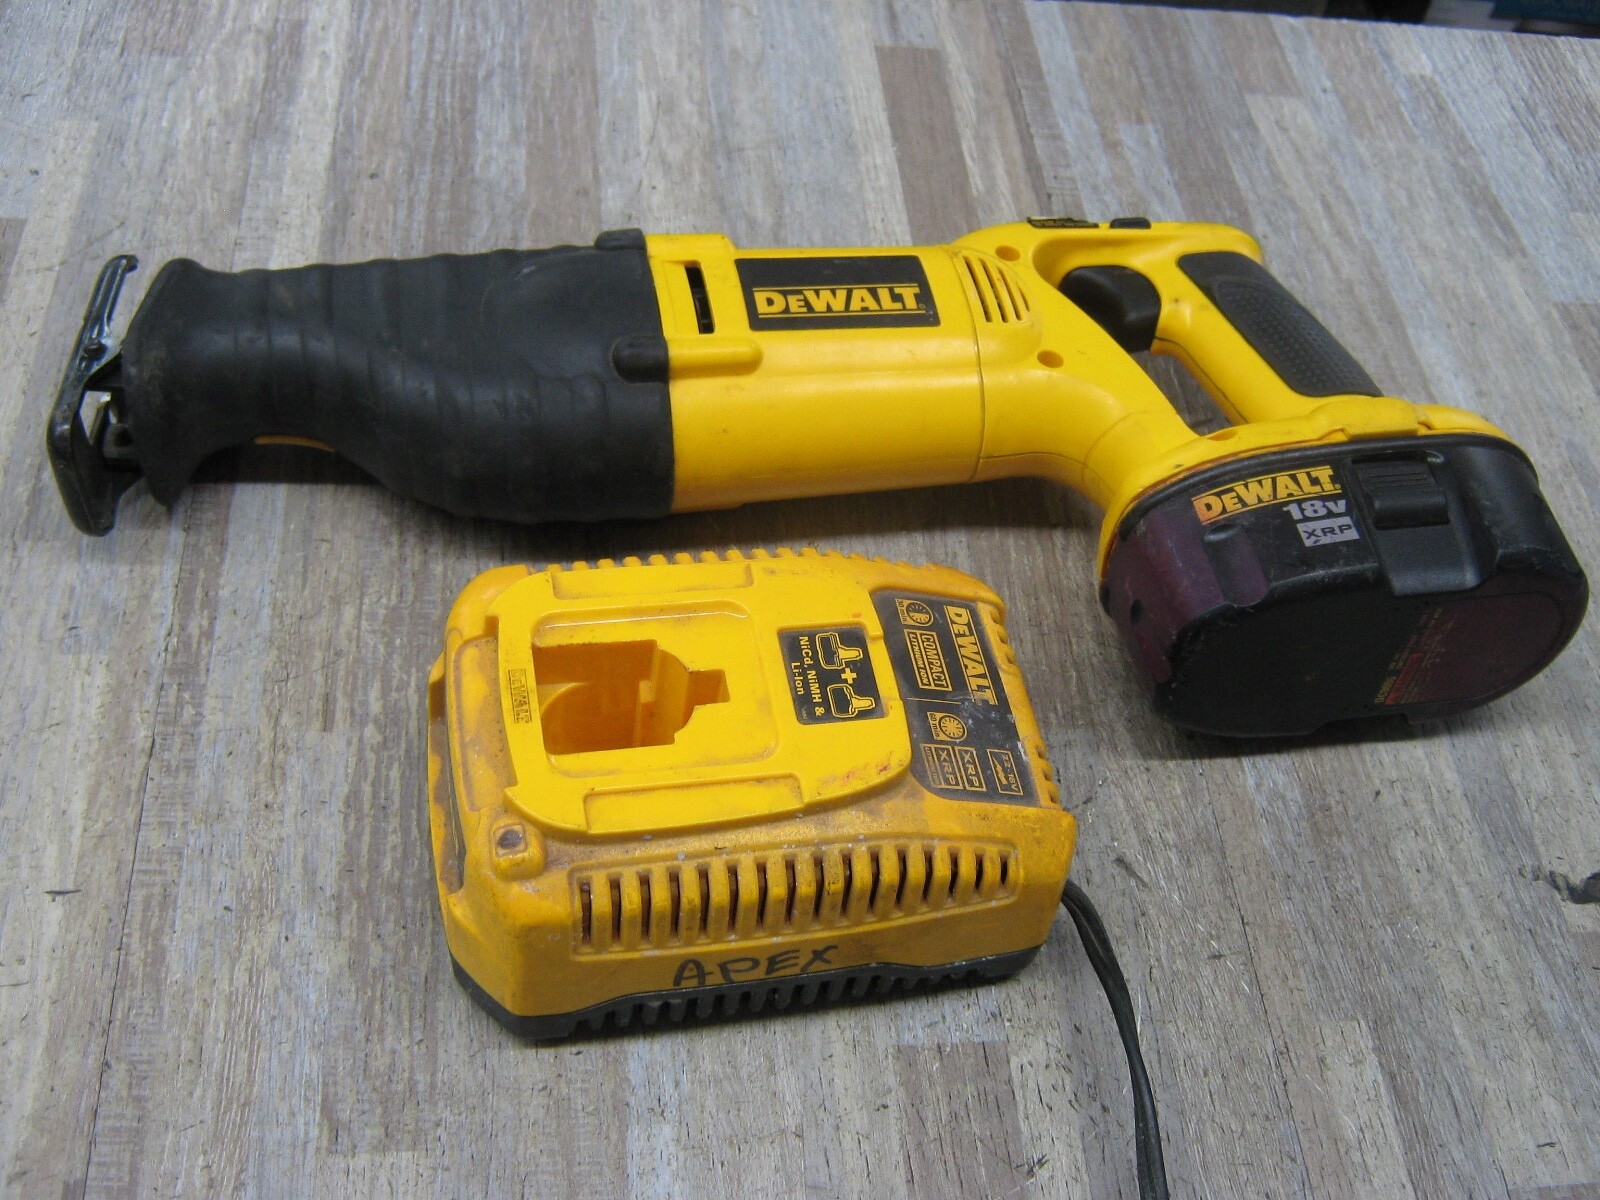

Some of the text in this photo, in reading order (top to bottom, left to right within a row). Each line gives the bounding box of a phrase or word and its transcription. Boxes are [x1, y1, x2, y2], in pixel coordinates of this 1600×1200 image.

[753, 286, 923, 315] DEWALT
[1192, 467, 1339, 523] DEWALT
[1302, 523, 1352, 540] XRP
[908, 633, 930, 686] LITHIUM ION
[921, 634, 948, 687] COMPACT
[945, 605, 997, 705] DEWALT
[791, 662, 805, 695] Li-Ion
[799, 636, 826, 717] NiCd, NiMH &
[929, 713, 937, 722] 60
[937, 749, 956, 786] XRP
[961, 751, 980, 787] XRP
[672, 944, 839, 987] APEX
